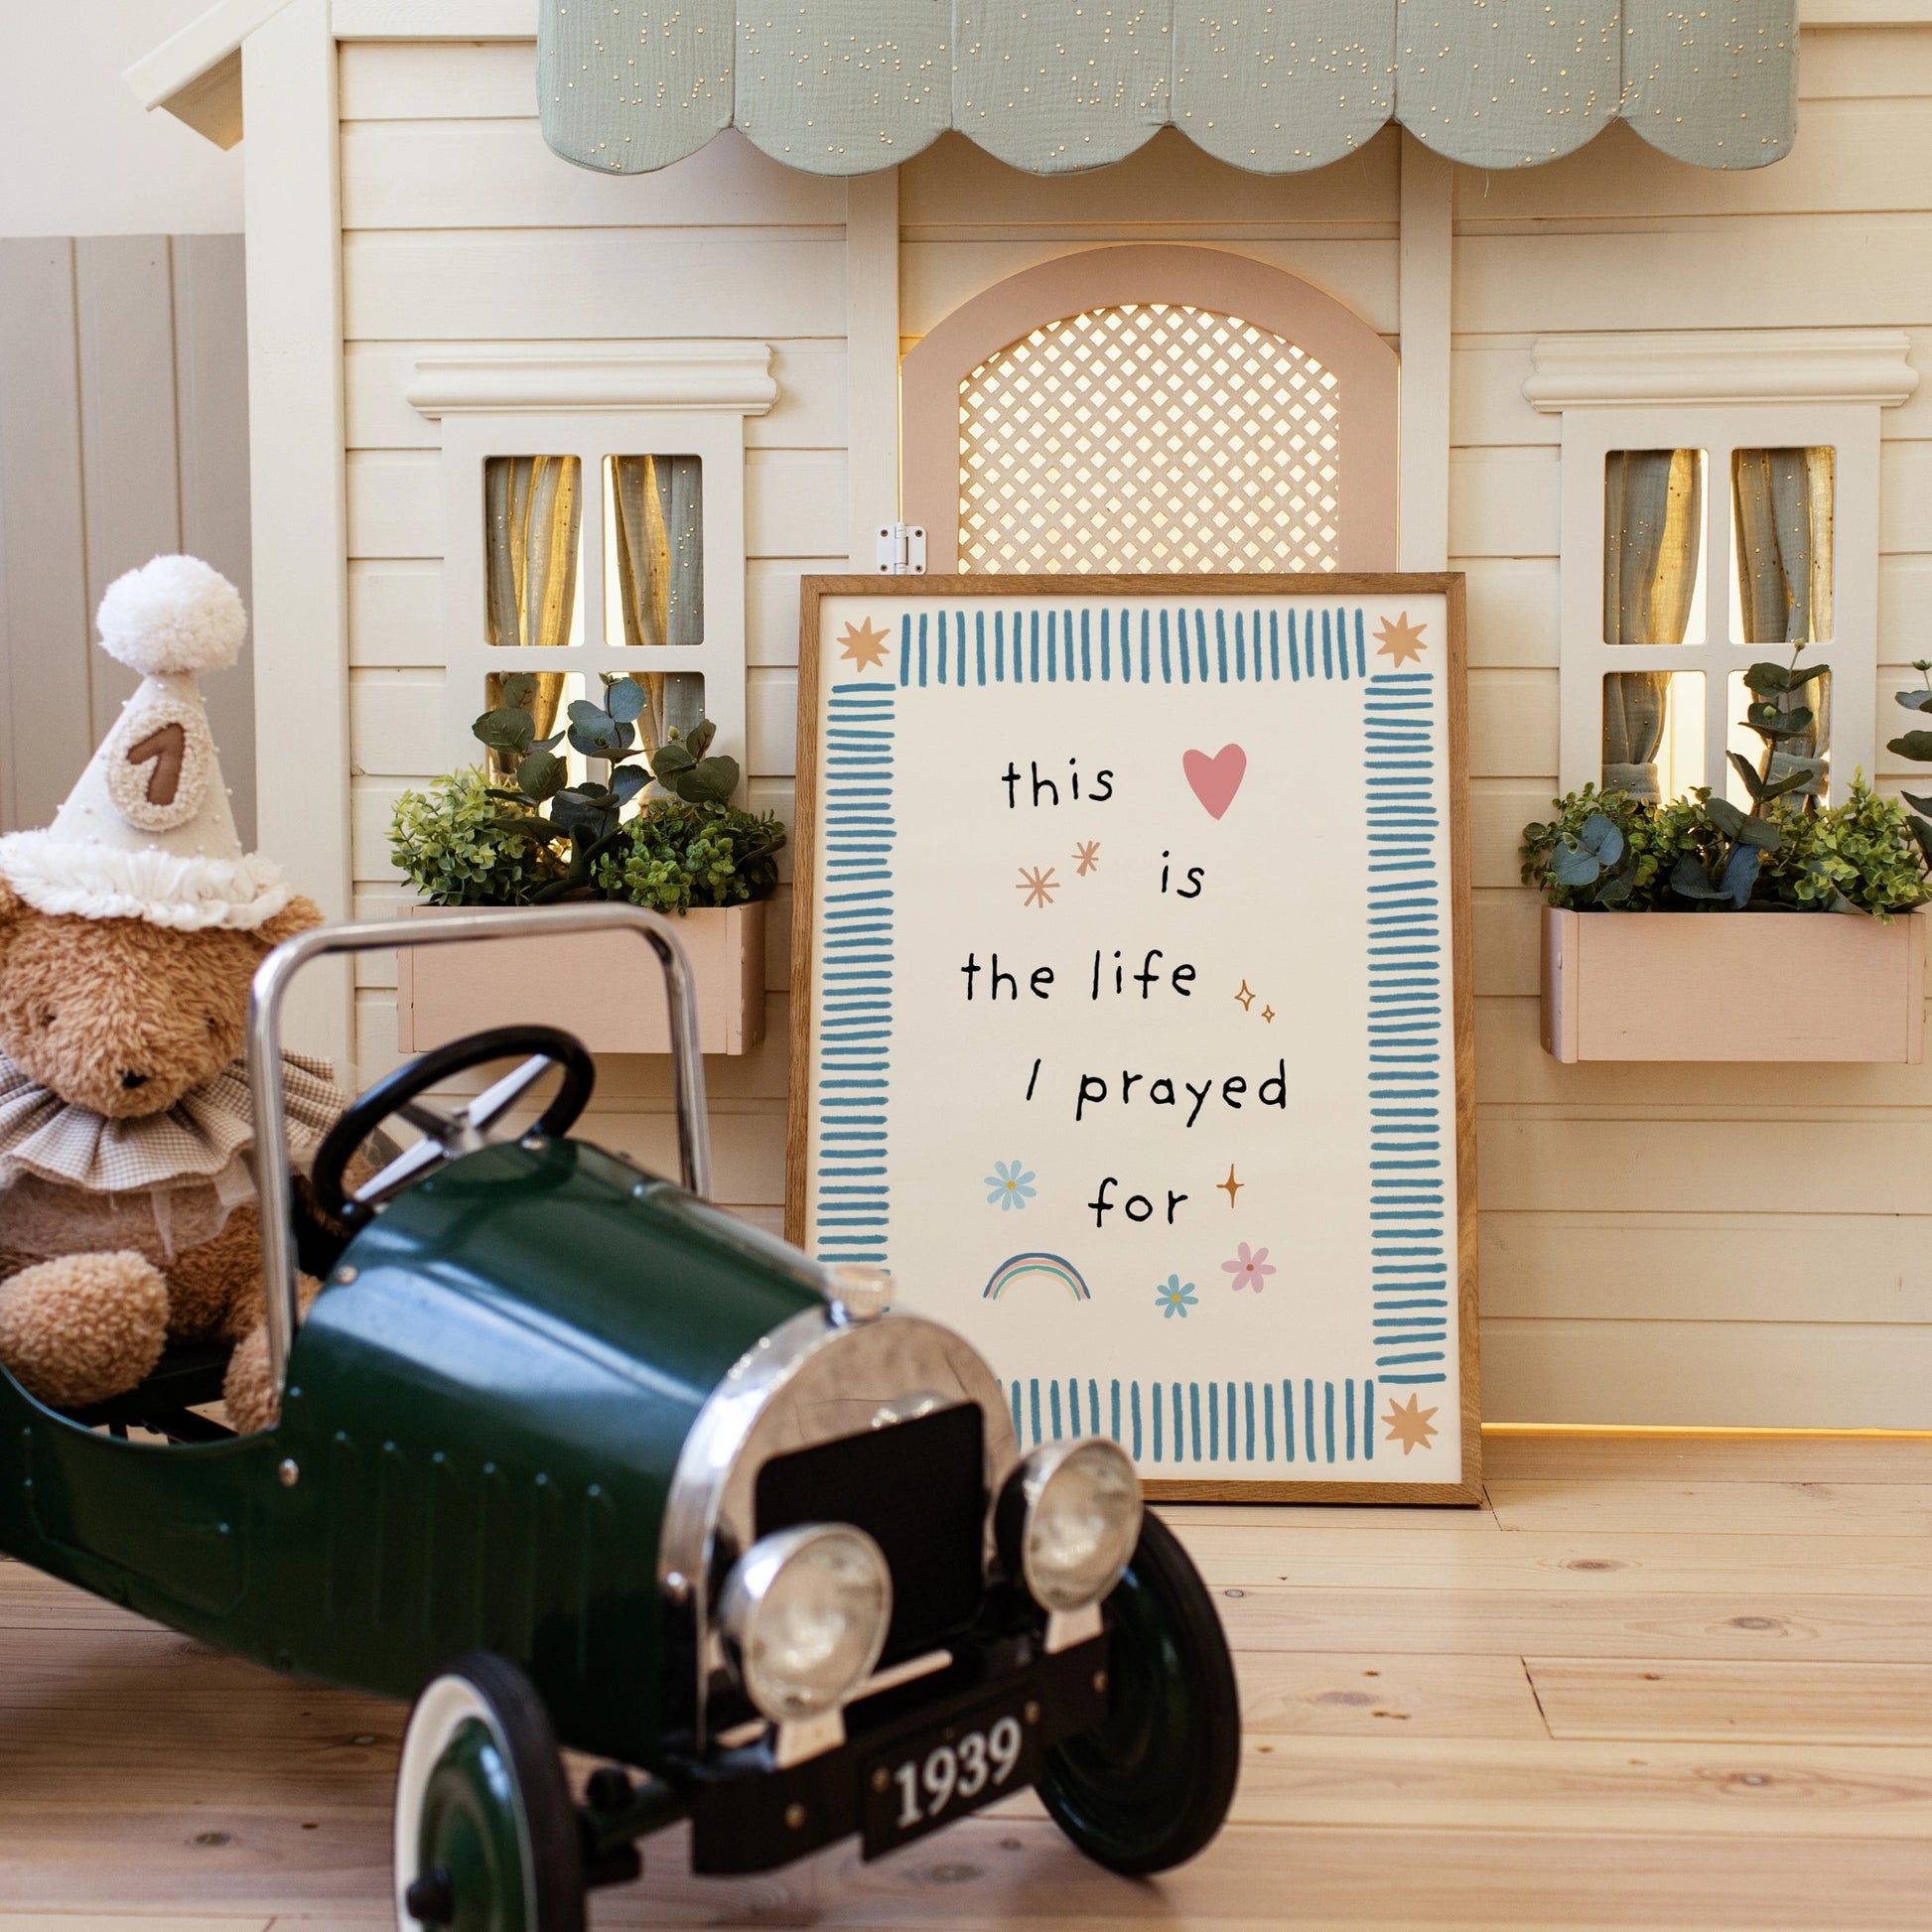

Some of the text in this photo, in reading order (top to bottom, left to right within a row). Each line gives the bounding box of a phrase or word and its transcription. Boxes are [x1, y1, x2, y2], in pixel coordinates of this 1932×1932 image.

[126, 722, 186, 807] 1
[1001, 758, 1114, 809] this
[1161, 850, 1205, 898] is
[960, 949, 1196, 1001] the life
[1026, 1057, 1287, 1129] I prayed
[1087, 1176, 1188, 1228] for
[895, 1716, 1023, 1829] 1939
